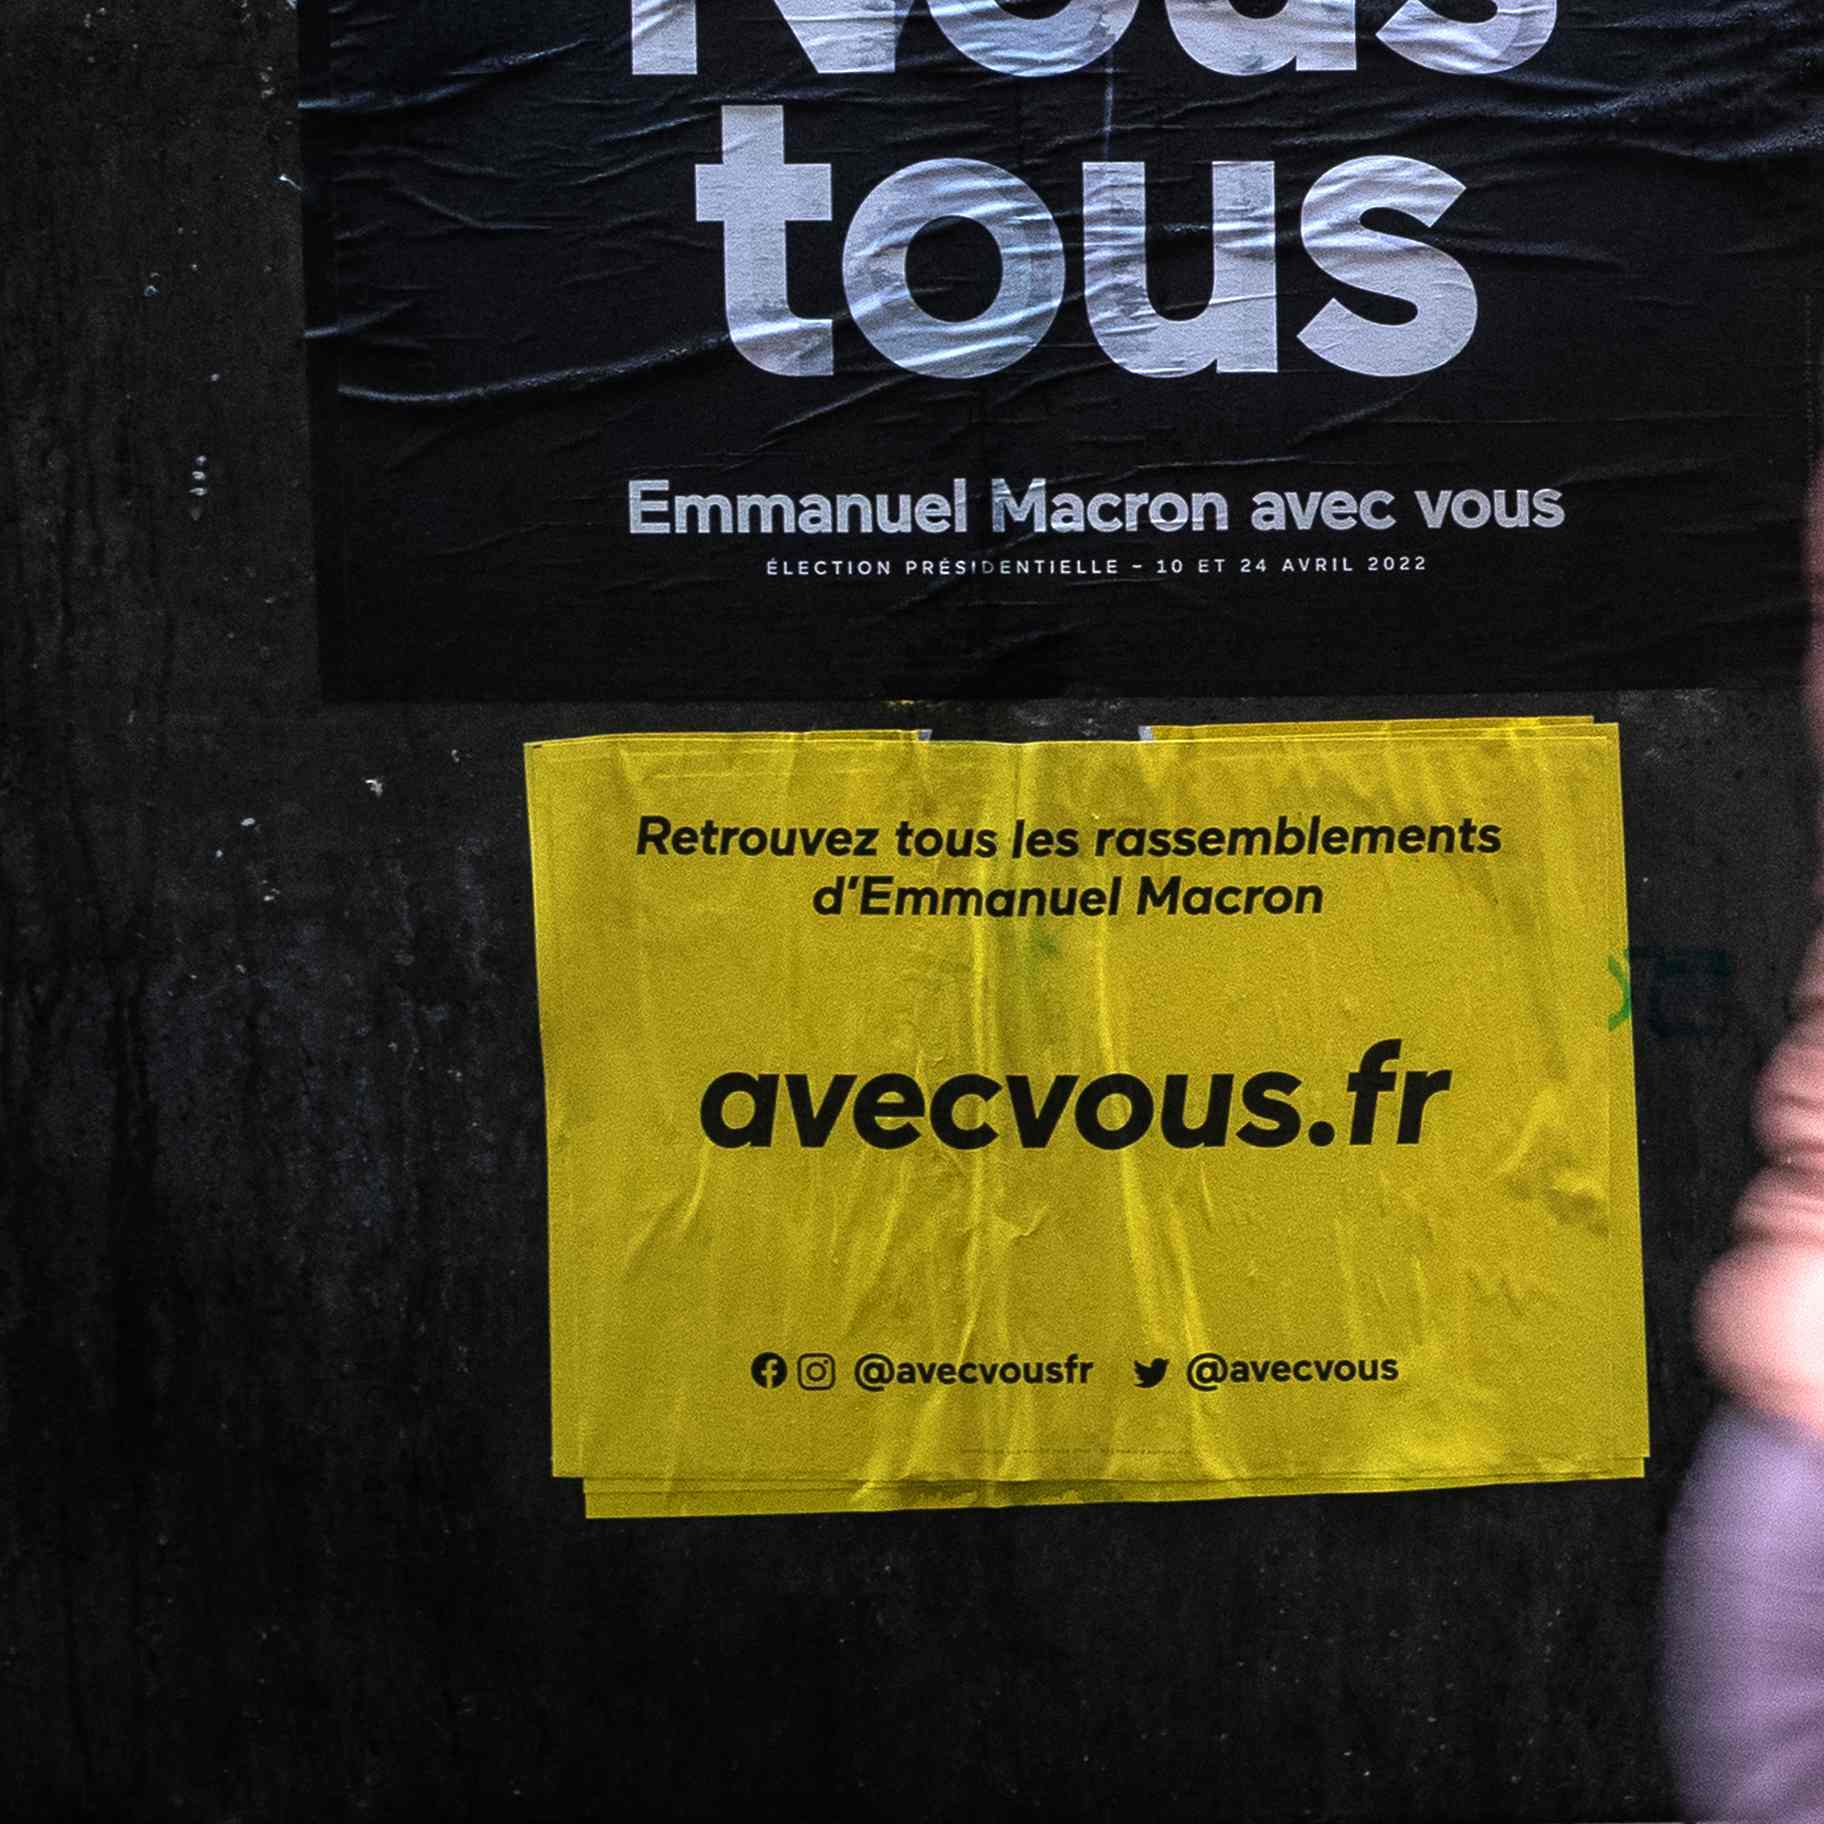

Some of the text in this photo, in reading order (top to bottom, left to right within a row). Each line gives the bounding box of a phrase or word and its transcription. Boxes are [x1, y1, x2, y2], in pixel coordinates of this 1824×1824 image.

[693, 103, 1479, 379] tous
[627, 477, 1566, 535] Emmanuel Macron avec vous
[766, 557, 891, 576] ÉLECTION
[905, 557, 1119, 575] PRÉSIDENTIELLE
[1156, 559, 1183, 574] 10
[1198, 559, 1226, 574] ET
[1240, 559, 1267, 573] 24
[1281, 557, 1353, 573] AVRIL
[1367, 556, 1426, 571] 2022
[636, 815, 1502, 859] Retrouvez tous les rassemblements
[812, 875, 1324, 918] d'Emmanuel Macron
[699, 1037, 1453, 1151] avecvous.fr
[854, 1351, 1399, 1393] @avecvousfr @avecvous
